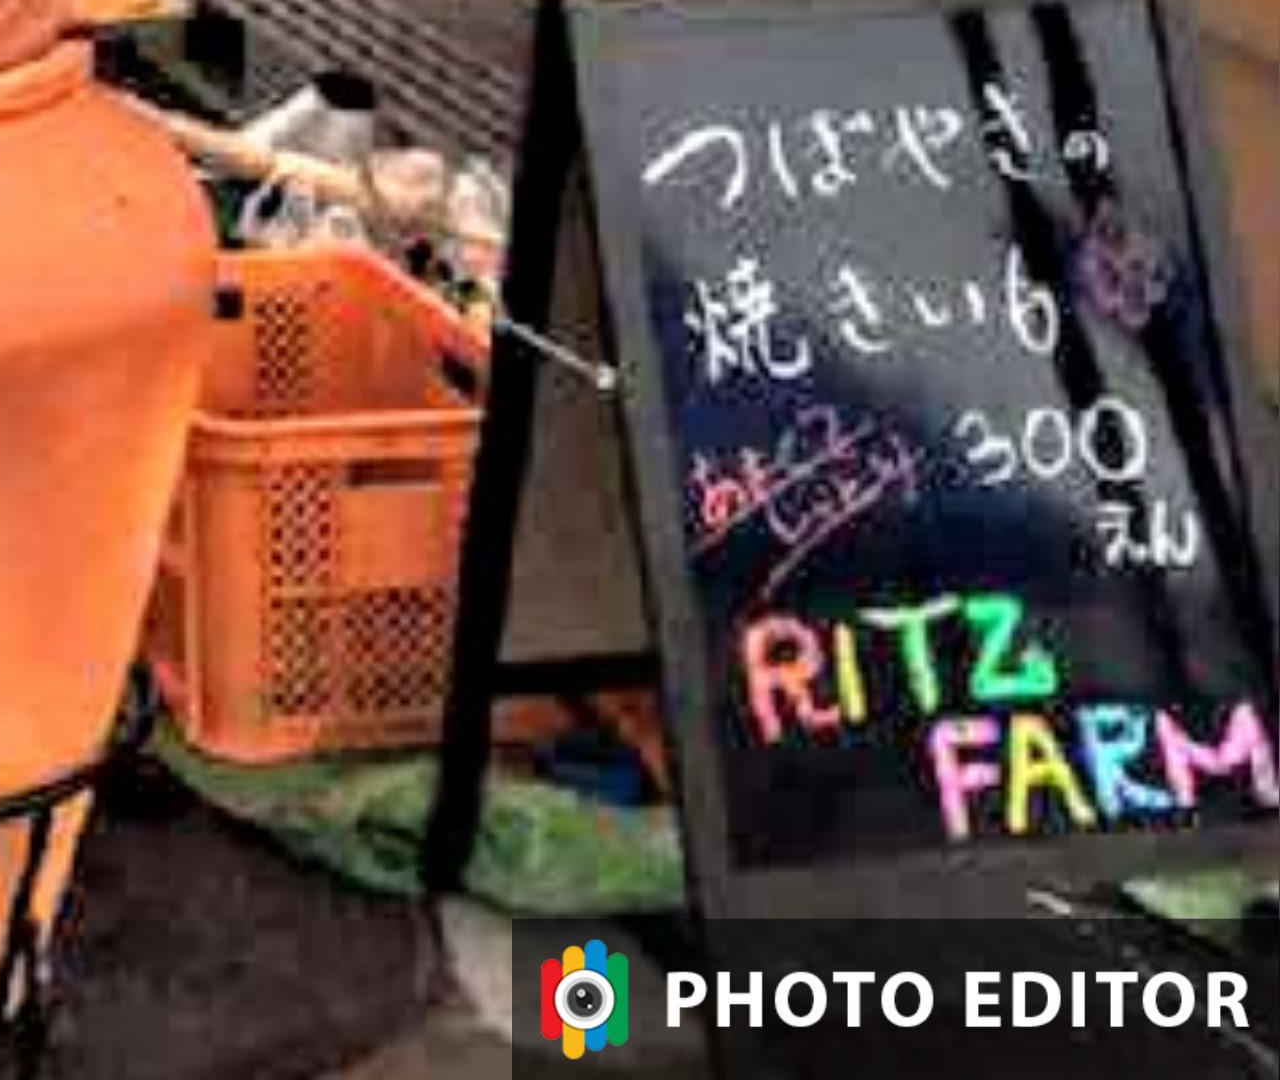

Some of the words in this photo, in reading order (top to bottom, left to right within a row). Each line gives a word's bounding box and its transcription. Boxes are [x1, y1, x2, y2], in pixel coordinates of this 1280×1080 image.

[954, 397, 1146, 486] 300
[744, 594, 1056, 744] RITZ
[930, 703, 1280, 840] FARM
